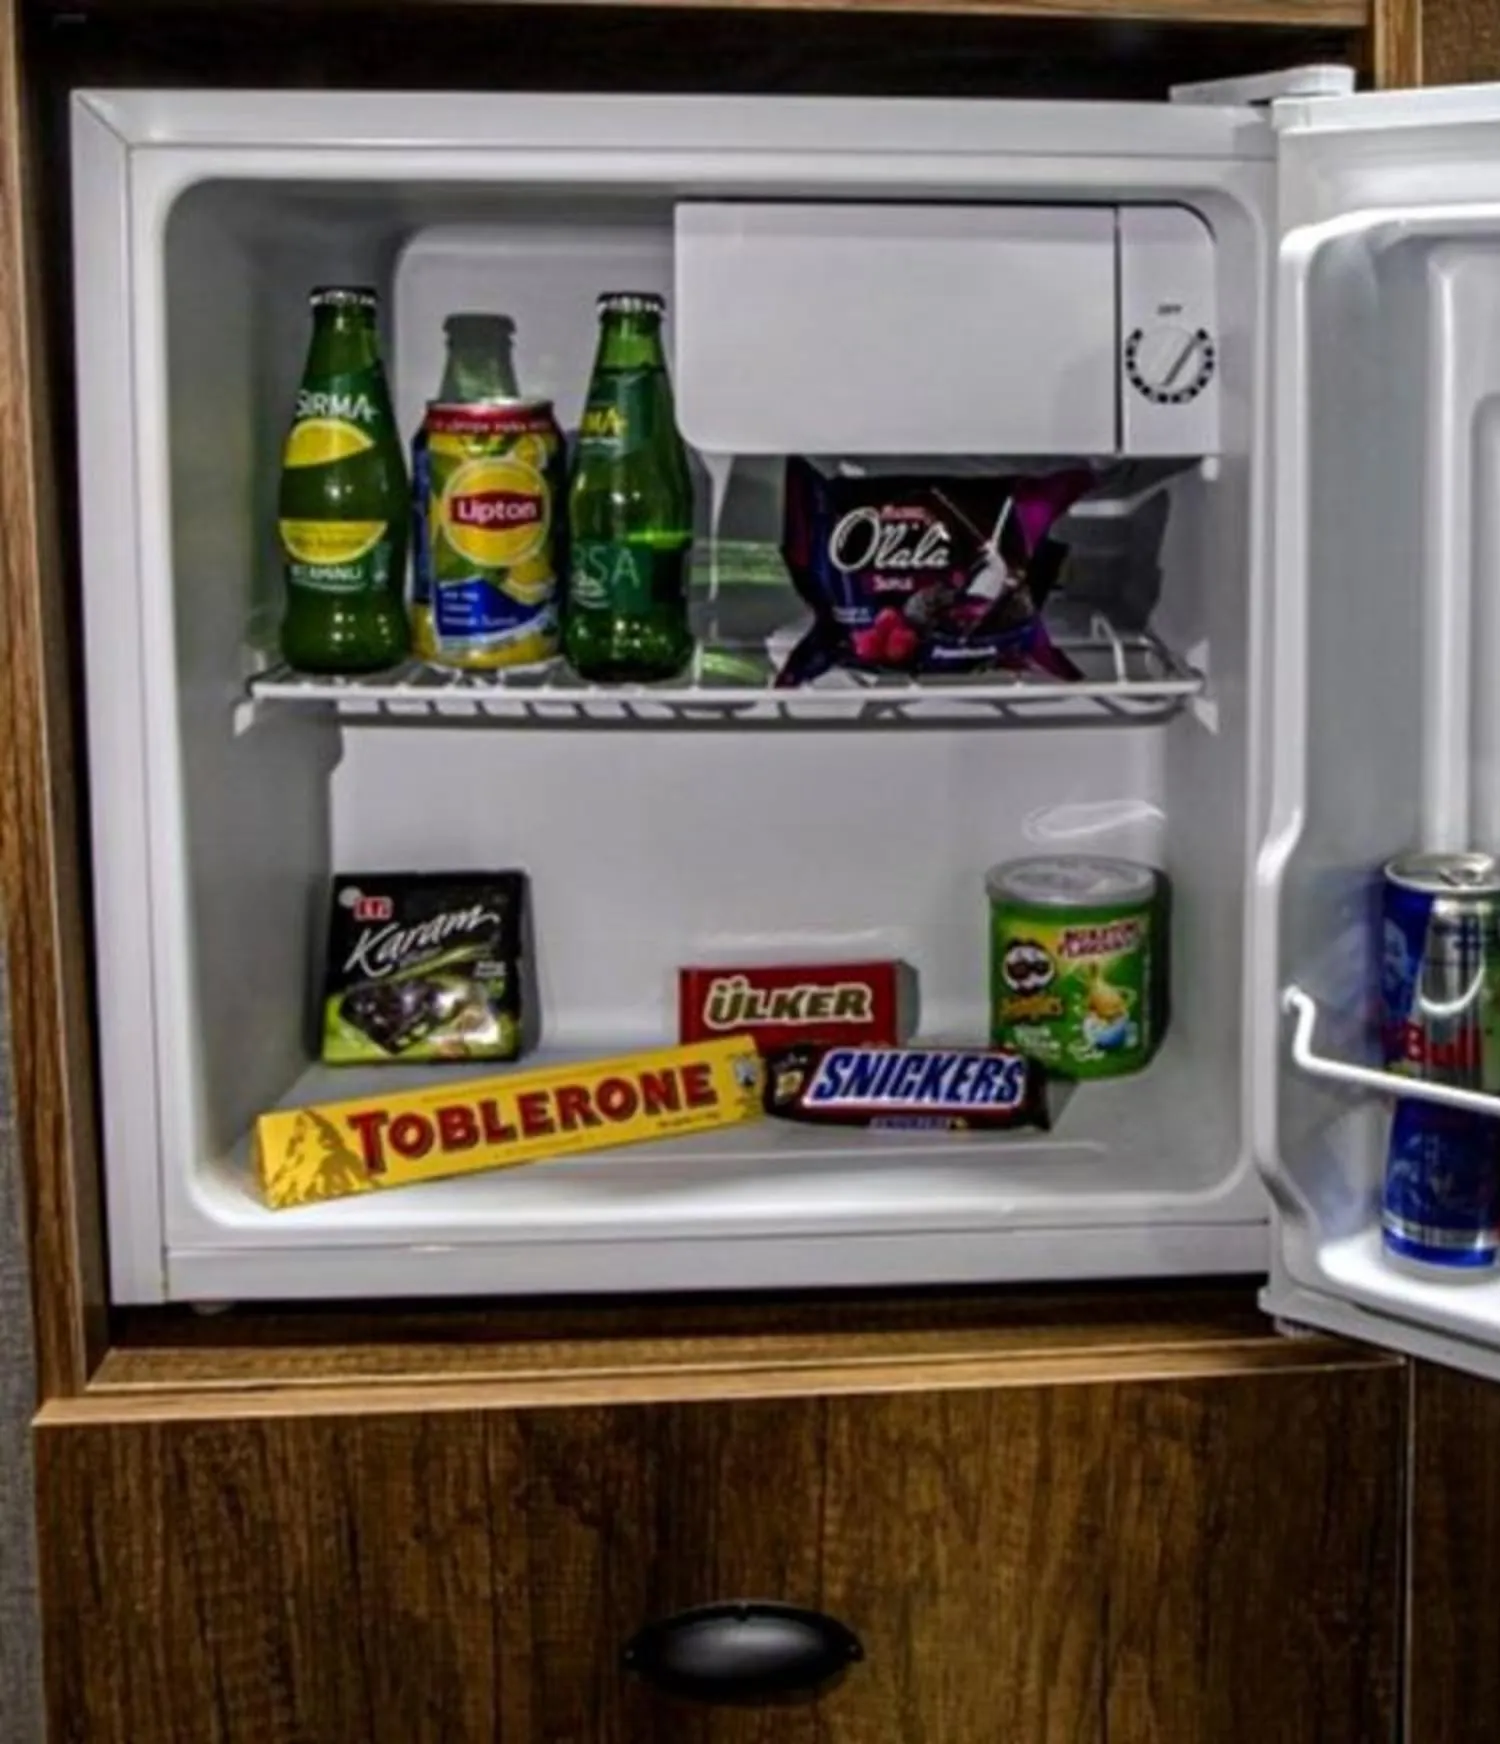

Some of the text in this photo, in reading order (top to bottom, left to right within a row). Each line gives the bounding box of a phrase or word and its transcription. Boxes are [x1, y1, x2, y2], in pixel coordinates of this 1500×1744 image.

[458, 499, 537, 523] Lipton
[343, 905, 500, 977] Karam
[706, 978, 872, 1024] ÜLKER
[811, 1051, 1024, 1103] SNICKERS
[347, 1064, 719, 1175] TOBLERONE
